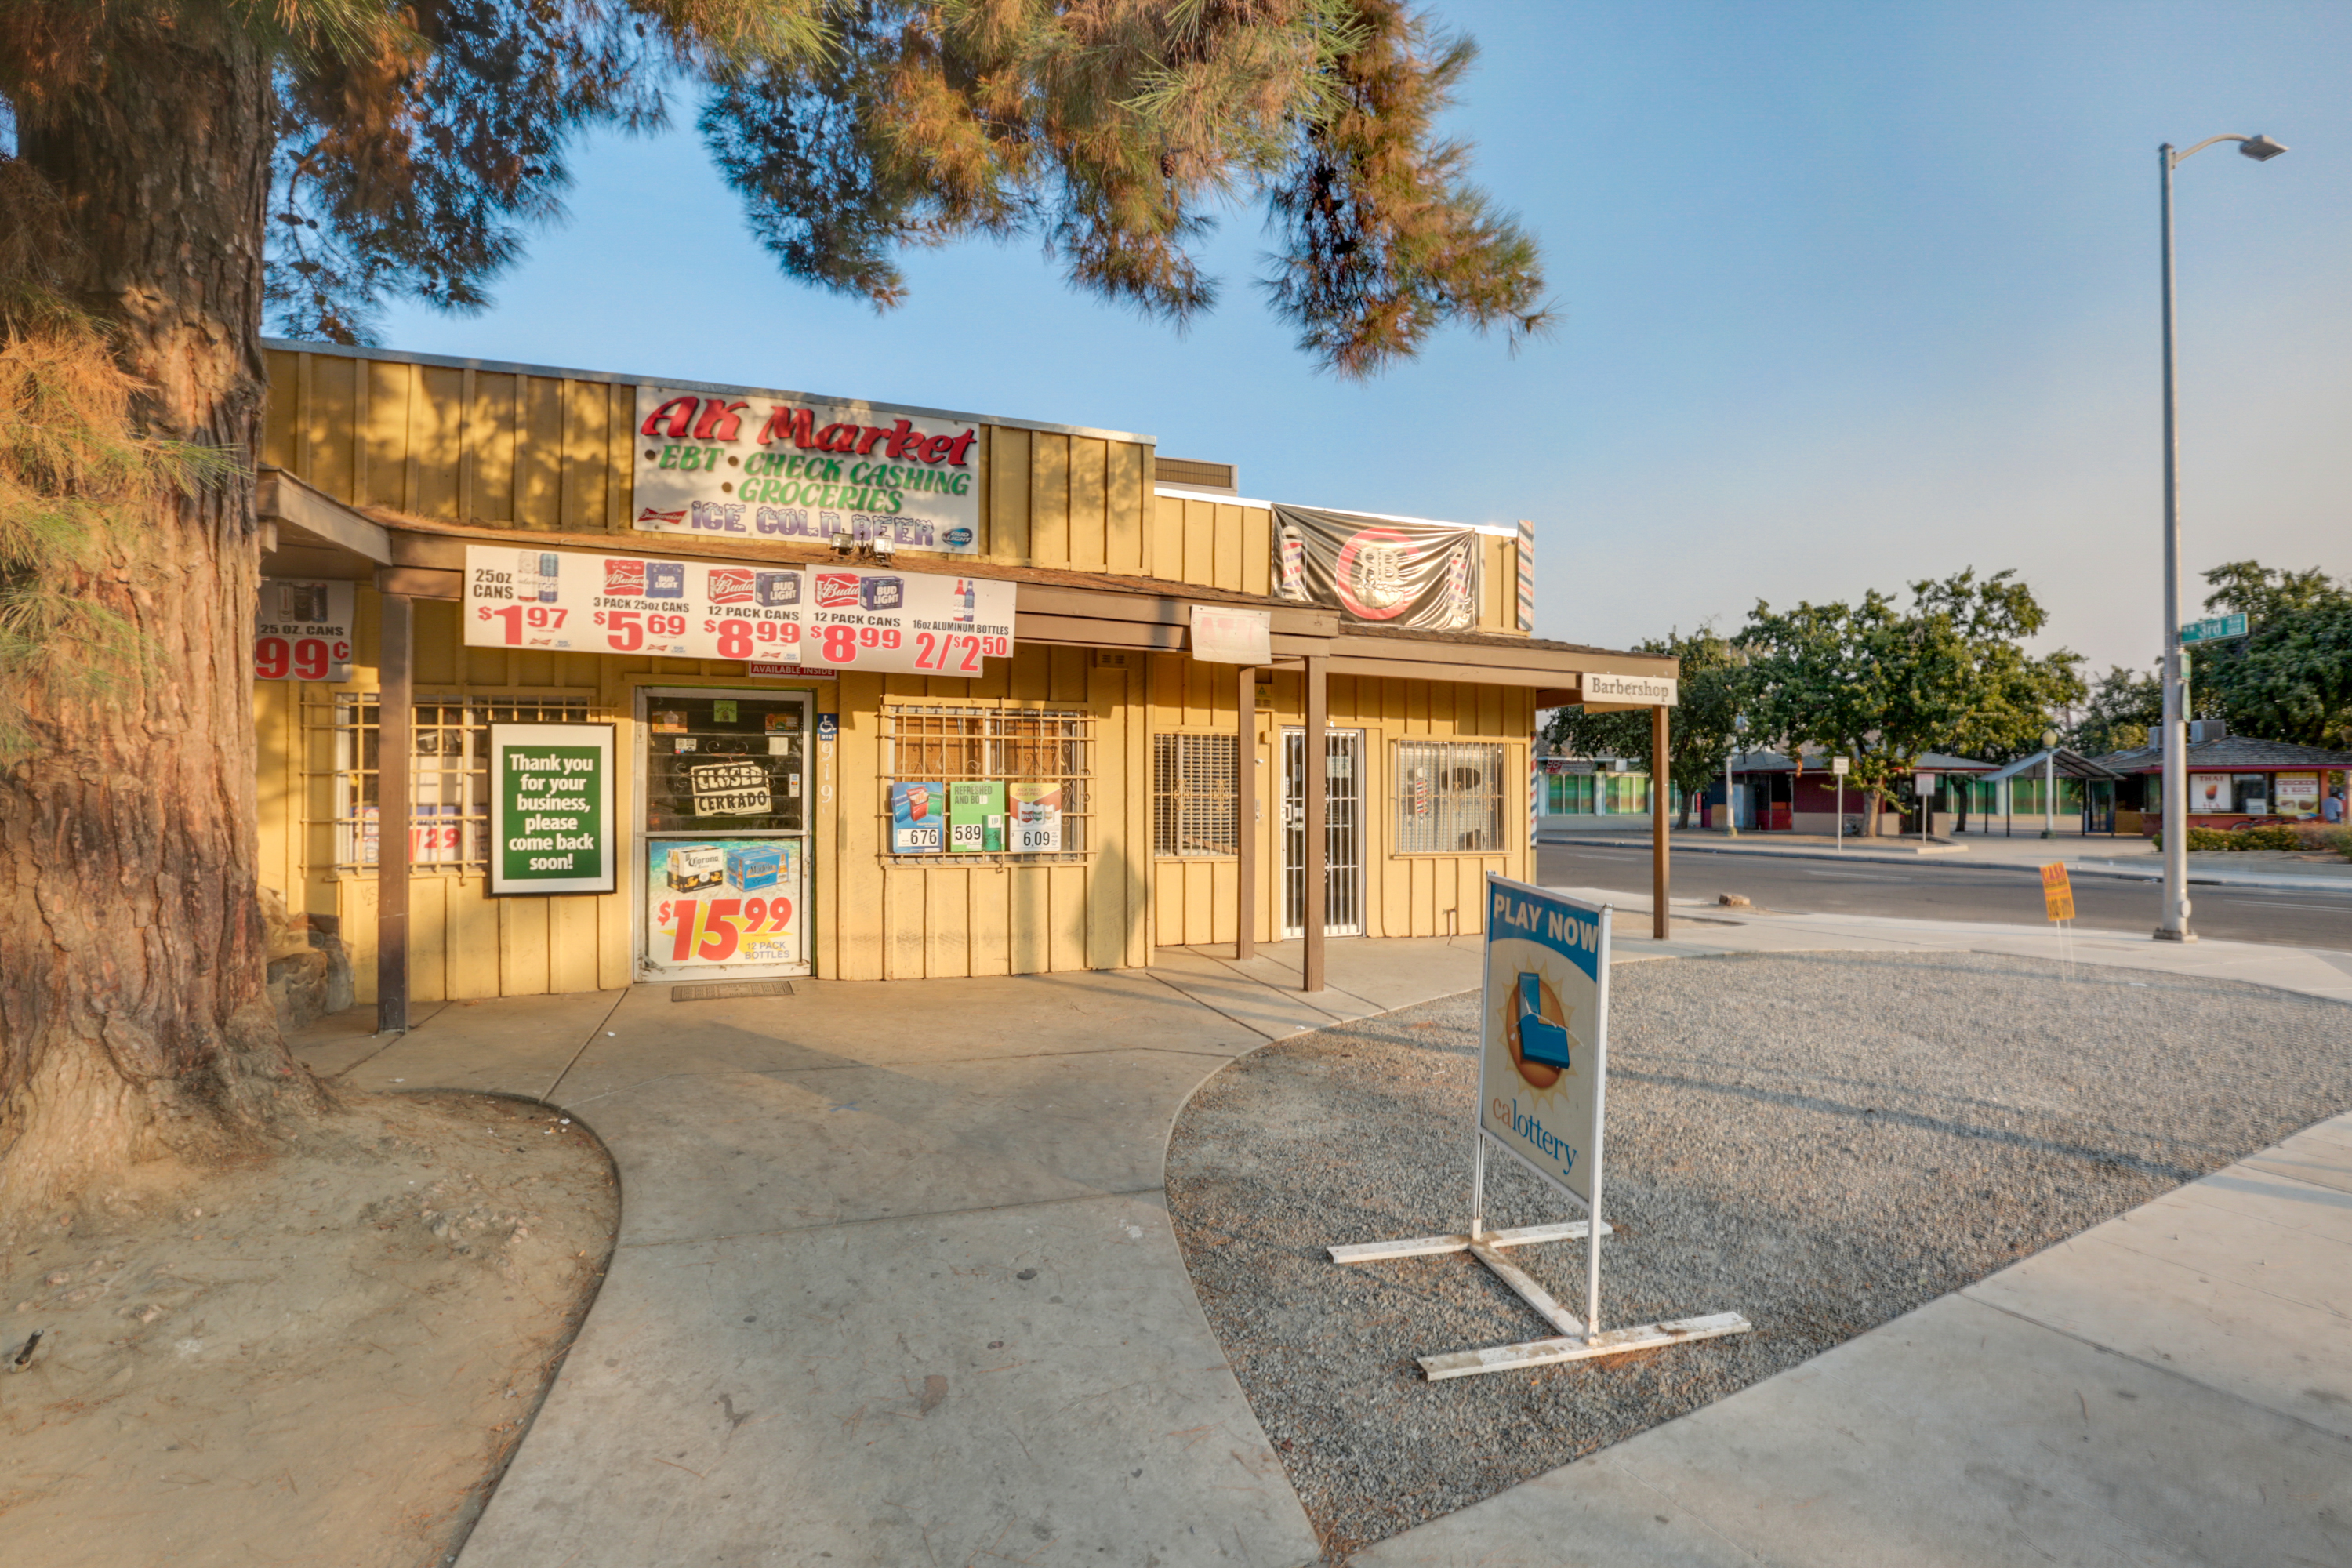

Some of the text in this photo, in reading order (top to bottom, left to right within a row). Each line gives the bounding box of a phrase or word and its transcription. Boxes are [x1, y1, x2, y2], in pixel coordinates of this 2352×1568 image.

[641, 397, 977, 465] AK Market
[659, 445, 971, 495] EBT CHECK CASHING
[739, 477, 903, 514] GROCERIES
[691, 500, 935, 546] ICE COLD BEER
[474, 584, 514, 600] CANS
[772, 582, 795, 591] BUD
[877, 586, 897, 595] BUD
[770, 590, 797, 601] LIGHT
[873, 593, 899, 604] LIGHT
[593, 597, 601, 607] 3
[604, 597, 631, 608] PACK
[662, 601, 689, 612] CANS
[707, 606, 799, 621] 12 PACK CANS
[814, 612, 901, 627] 12 PACK CANS
[260, 624, 278, 634] 25
[306, 626, 344, 636] CANS
[933, 621, 975, 633] ALUMINUM
[977, 624, 1009, 636] BOTTLES
[753, 665, 800, 674] AVAILABLE
[1592, 677, 1668, 702] Barbershop
[509, 753, 593, 775] Thank you
[520, 774, 587, 795] for your
[698, 766, 763, 789] CLOSED
[955, 786, 993, 795] REFRESHED
[517, 793, 590, 813] business,
[699, 791, 767, 811] CERRADO
[955, 795, 969, 804] AND
[525, 814, 578, 835] please
[509, 833, 594, 851] come back
[1024, 831, 1050, 847] 6.09
[529, 853, 573, 870] soon!
[688, 855, 719, 867] Corona
[750, 863, 773, 875] Modelo
[1494, 893, 1599, 954] PLAY NOW
[760, 941, 786, 949] PACK
[745, 950, 790, 959] BOTTLES
